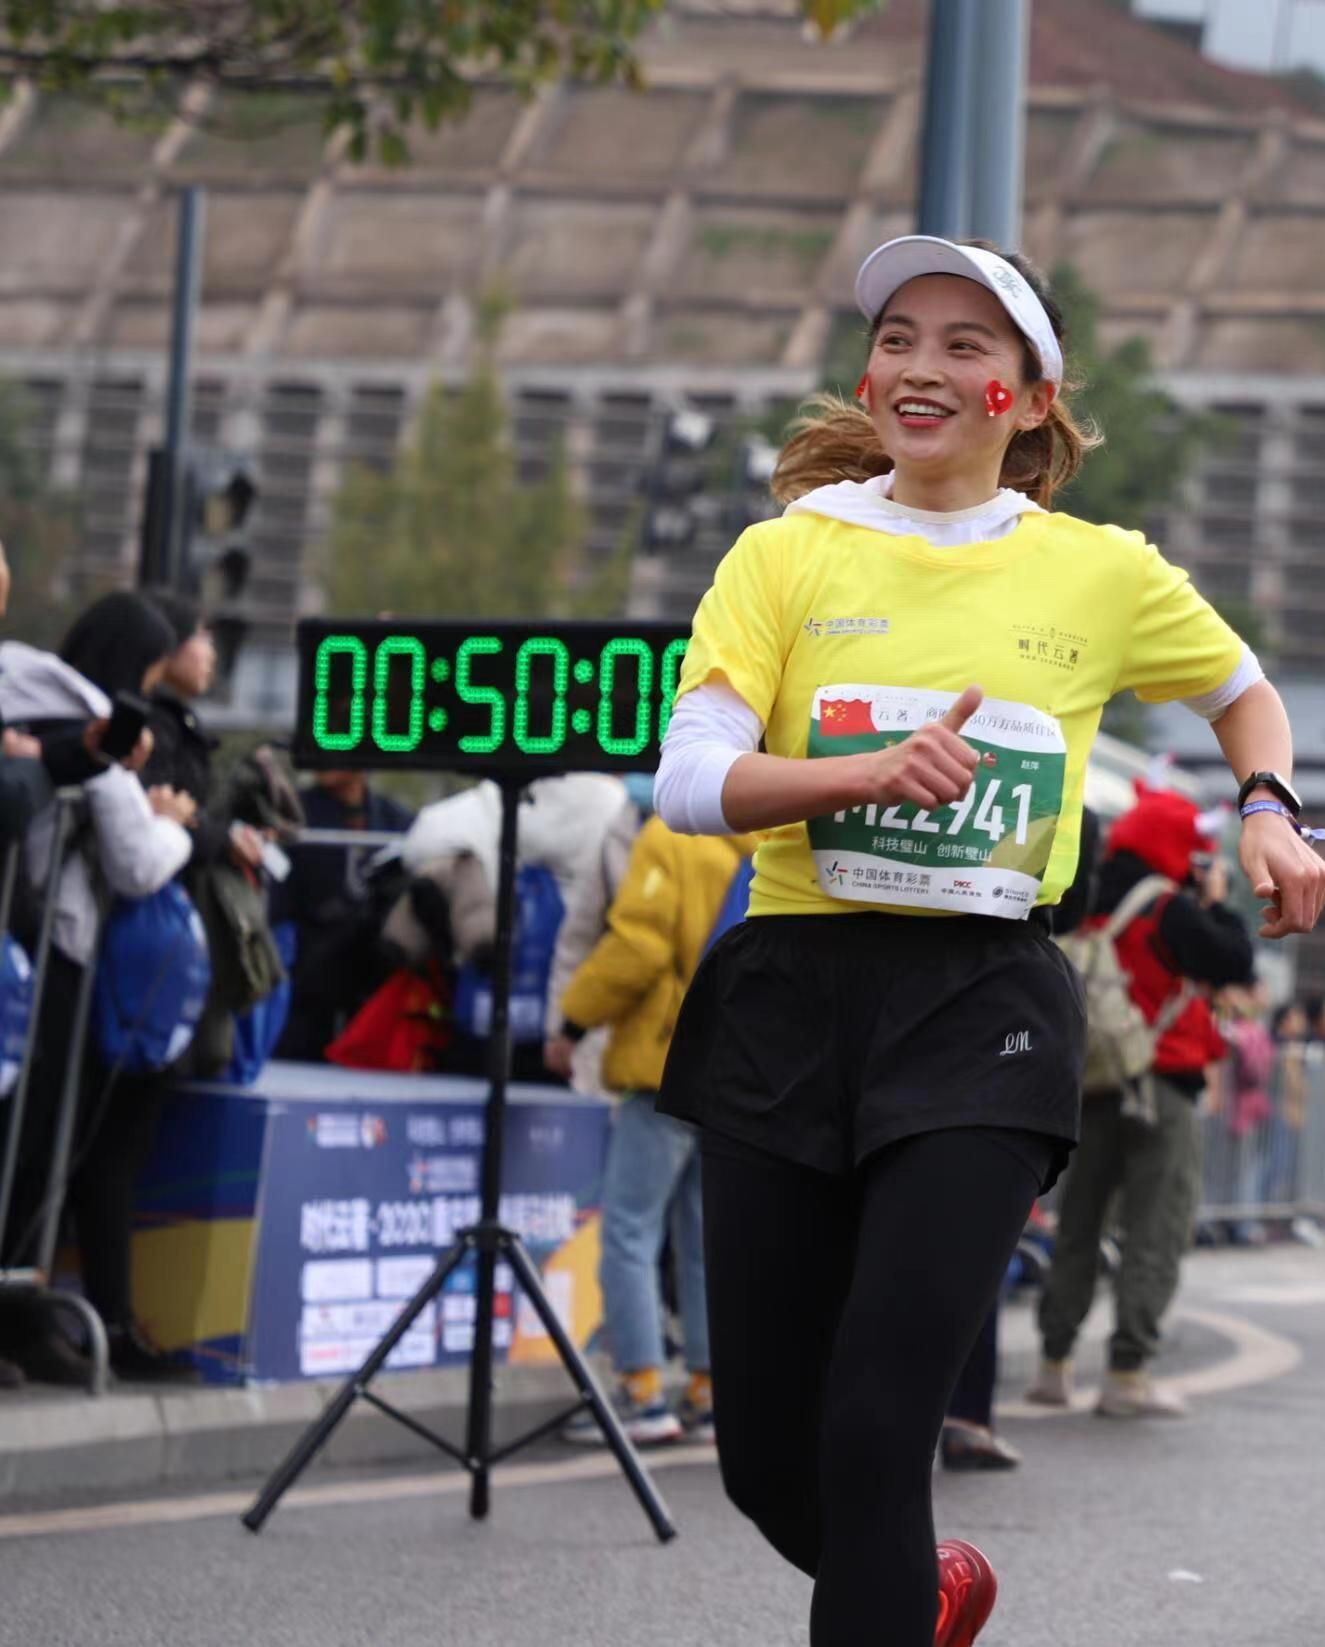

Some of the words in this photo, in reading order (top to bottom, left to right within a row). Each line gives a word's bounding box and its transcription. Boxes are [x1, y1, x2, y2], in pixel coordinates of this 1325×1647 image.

[852, 867, 931, 887] 中国体育彩票
[852, 880, 872, 889] CHINA
